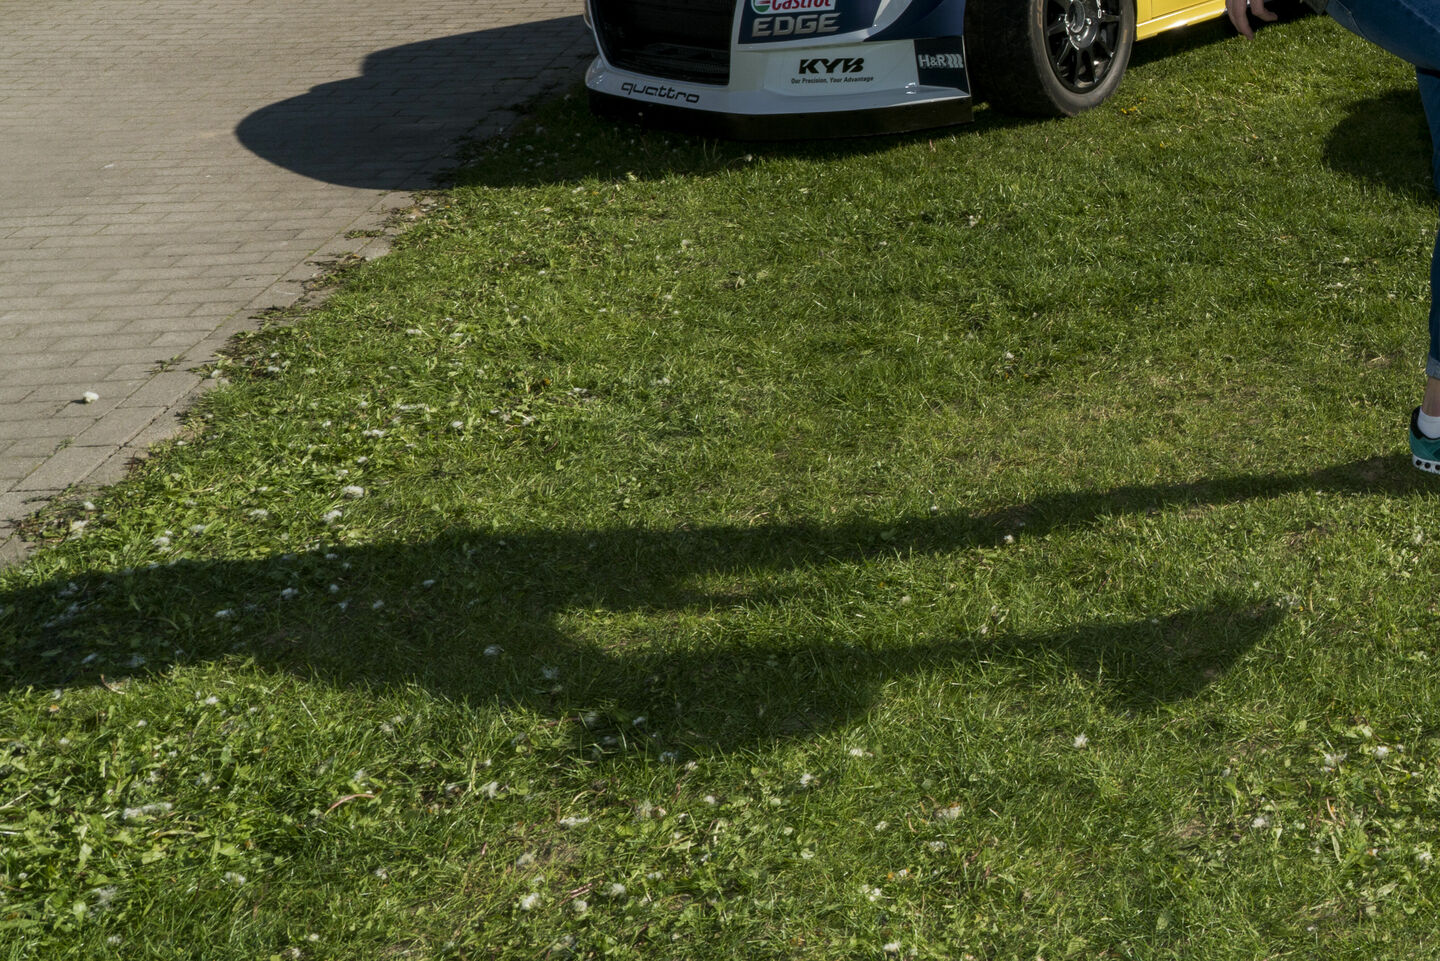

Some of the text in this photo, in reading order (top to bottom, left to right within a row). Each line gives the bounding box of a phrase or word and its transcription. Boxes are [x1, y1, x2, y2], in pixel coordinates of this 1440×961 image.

[752, 13, 841, 38] EDGE
[799, 57, 865, 75] KYB
[918, 53, 946, 70] H&R
[802, 76, 828, 85] Precision,
[830, 76, 843, 84] Your
[844, 76, 874, 85] Advantage
[621, 80, 701, 104] quattro
